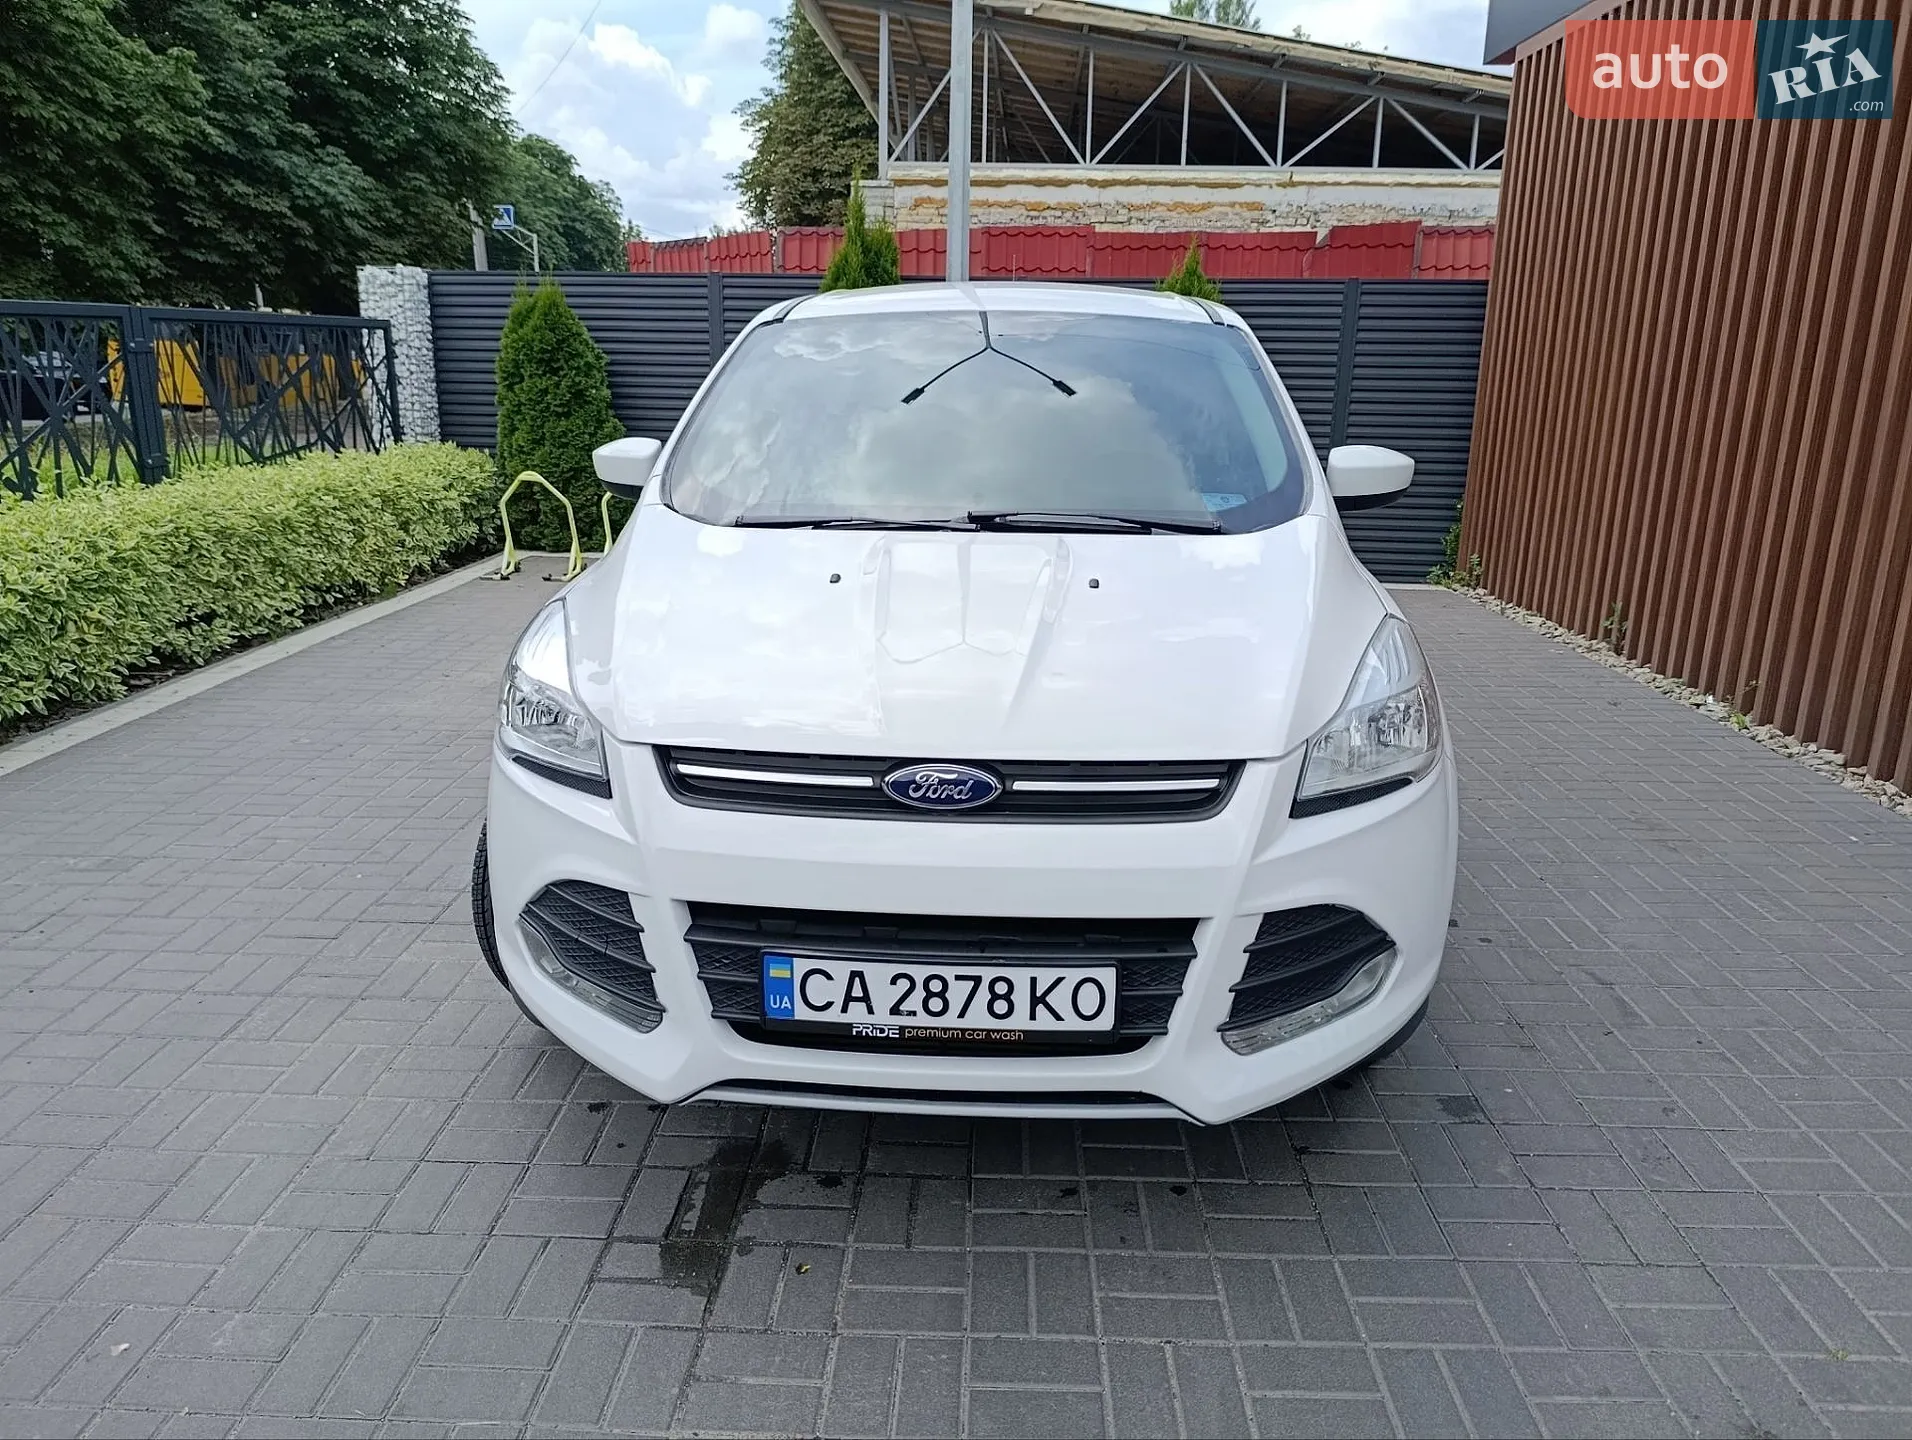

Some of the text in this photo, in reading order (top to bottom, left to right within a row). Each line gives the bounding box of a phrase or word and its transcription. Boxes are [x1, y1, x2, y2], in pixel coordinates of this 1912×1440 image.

[908, 771, 974, 799] Ford
[769, 994, 792, 1010] UA
[799, 967, 1107, 1022] CA 2878 KO
[904, 1027, 962, 1040] premium
[964, 1030, 987, 1040] car
[990, 1028, 1024, 1041] wash
